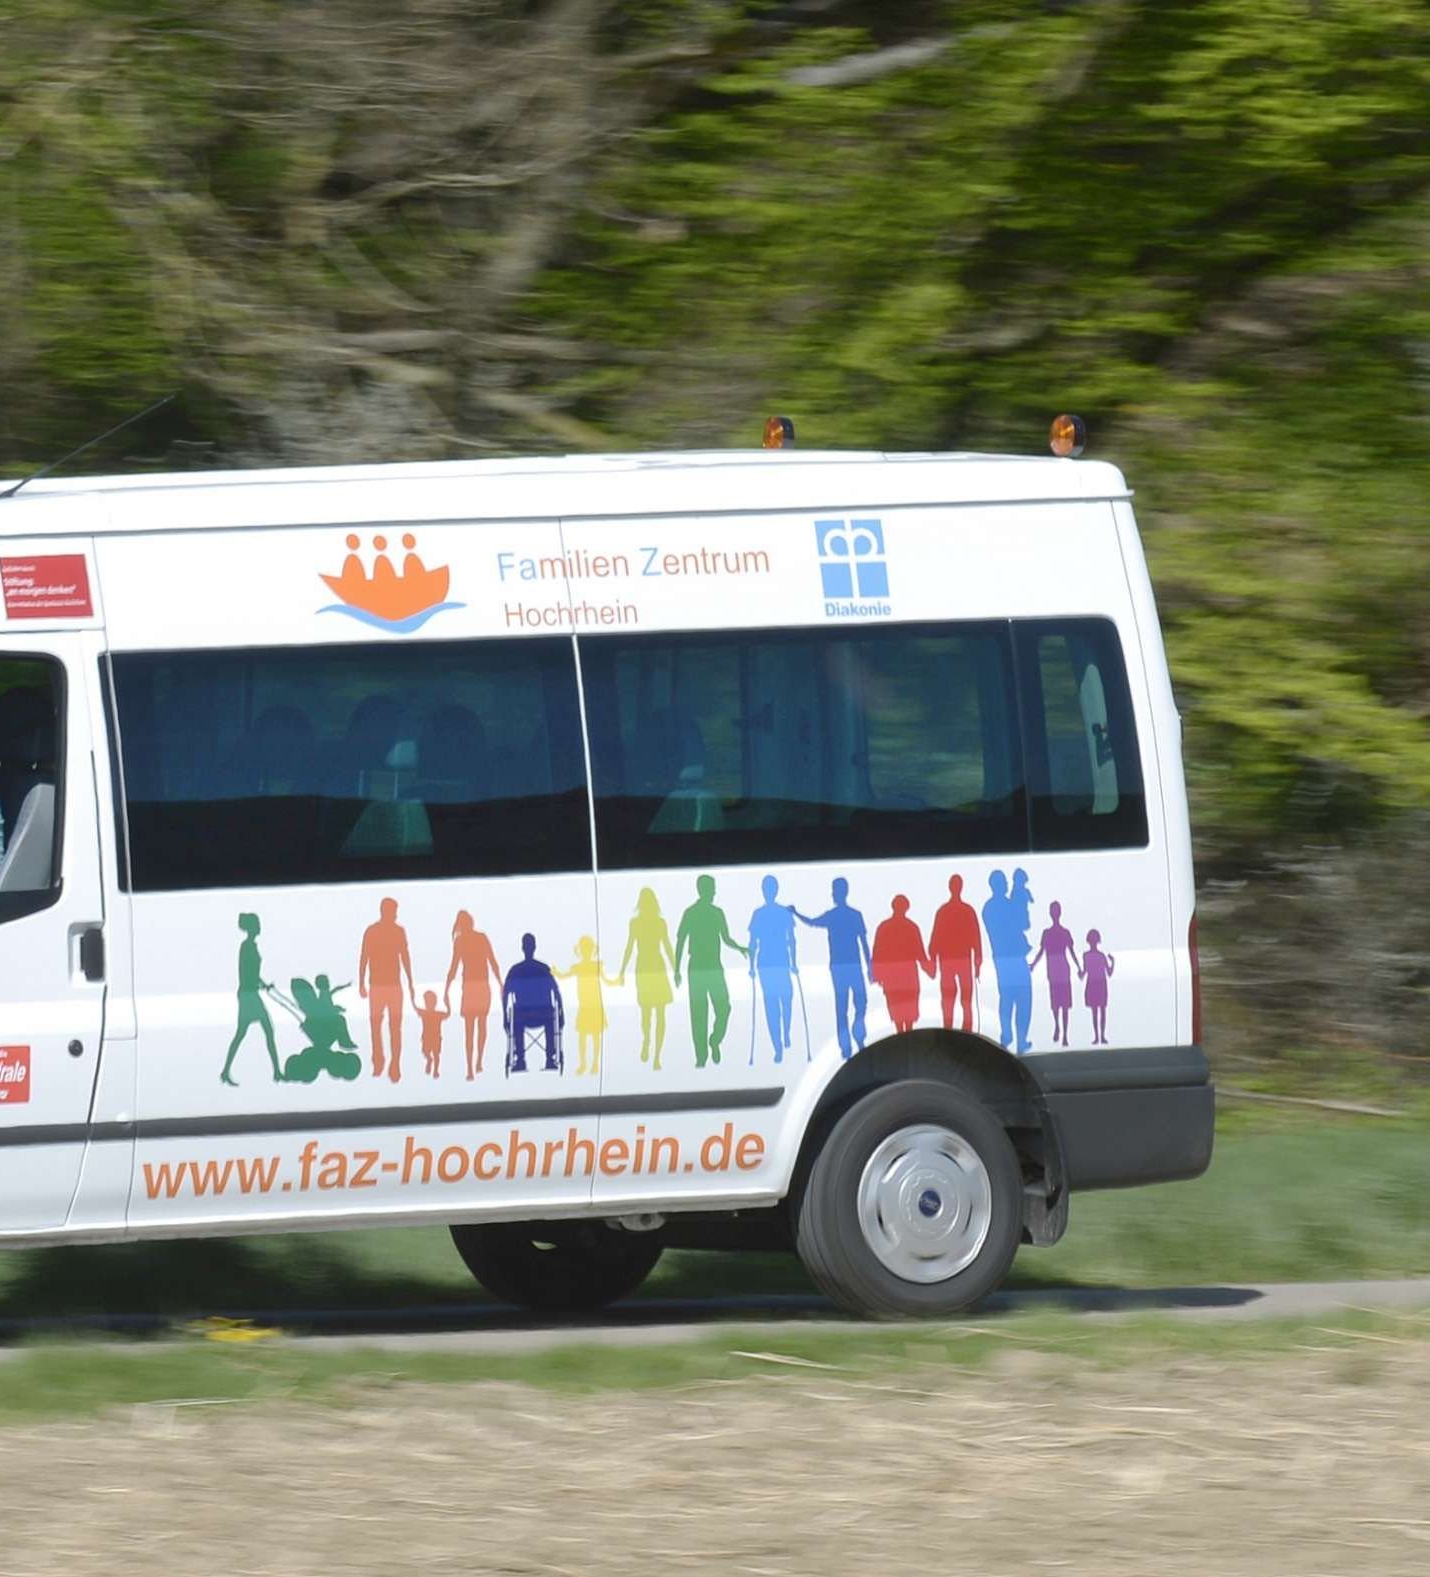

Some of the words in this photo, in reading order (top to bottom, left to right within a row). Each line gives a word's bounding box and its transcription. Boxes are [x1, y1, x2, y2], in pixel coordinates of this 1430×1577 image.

[497, 549, 630, 582] Familien
[640, 546, 770, 577] Zentrum
[504, 601, 639, 628] Hochrhein
[825, 601, 892, 618] Diakonie
[142, 1122, 766, 1200] www.faz-hochrhein.de
